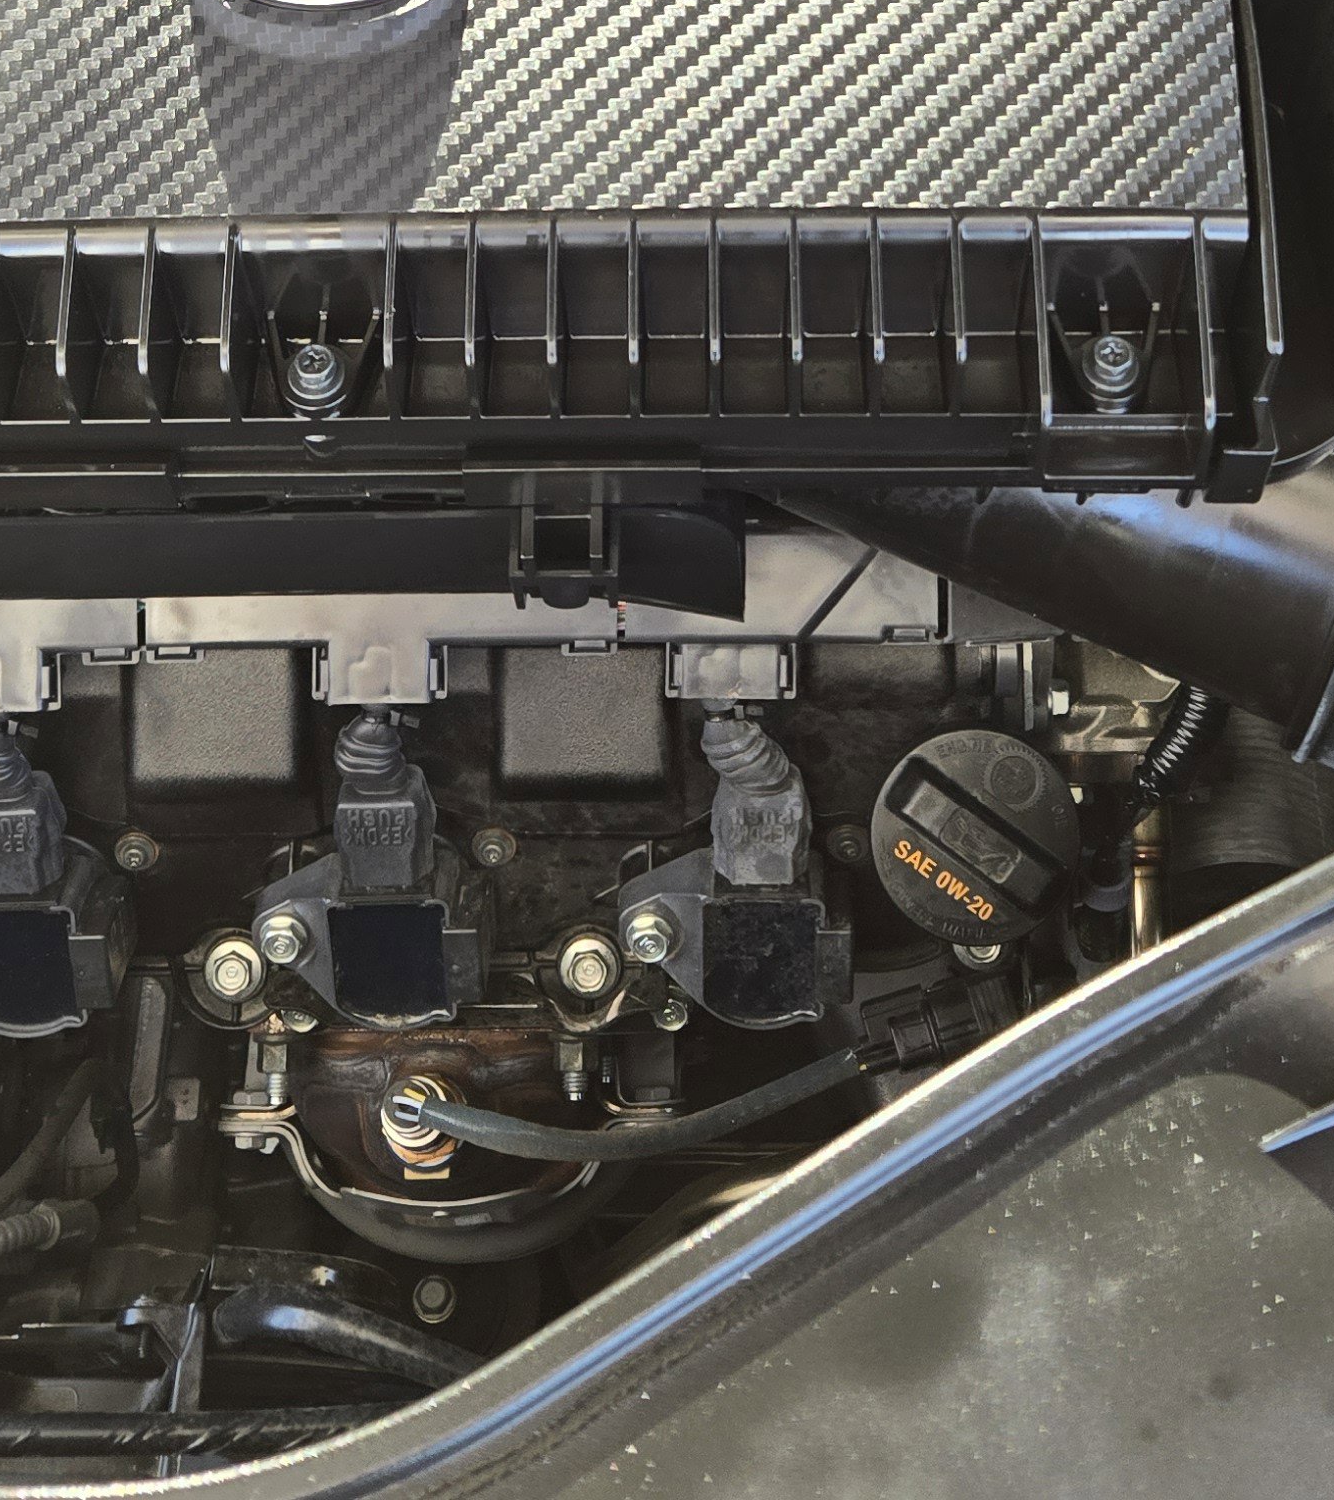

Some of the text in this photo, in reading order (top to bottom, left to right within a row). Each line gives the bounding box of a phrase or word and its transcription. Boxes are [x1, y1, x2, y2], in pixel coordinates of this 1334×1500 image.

[346, 808, 406, 827] PUSH
[894, 840, 937, 879] SAE
[935, 870, 994, 921] 0W-20
